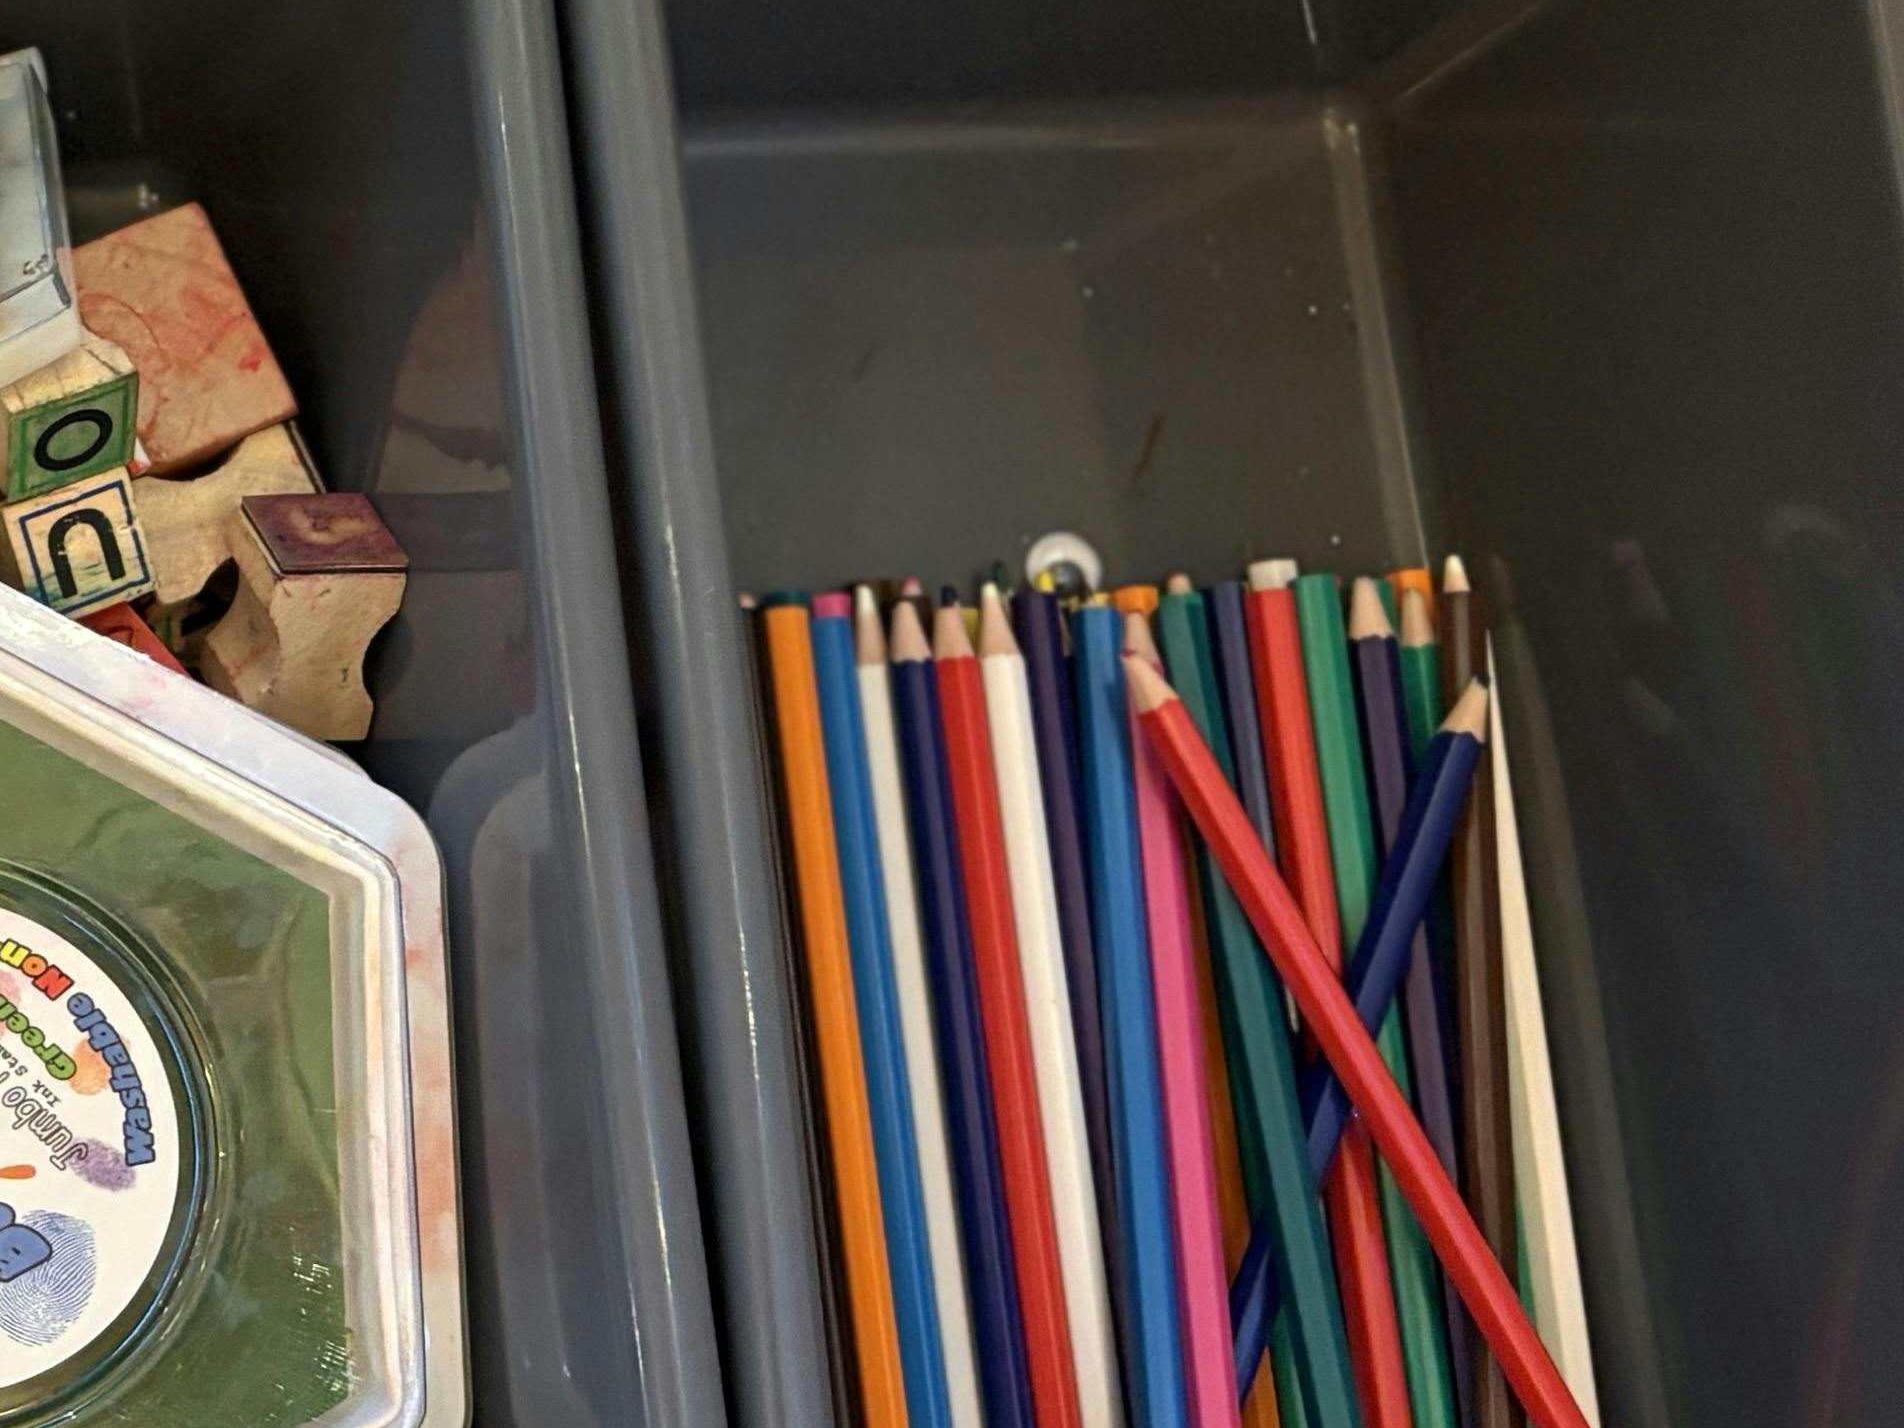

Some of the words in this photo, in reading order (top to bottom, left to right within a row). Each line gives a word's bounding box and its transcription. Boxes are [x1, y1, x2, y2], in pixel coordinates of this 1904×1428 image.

[34, 408, 114, 472] O
[32, 1078, 62, 1108] Ink
[67, 991, 156, 1167] Washable
[1, 1085, 90, 1171] Jumbo
